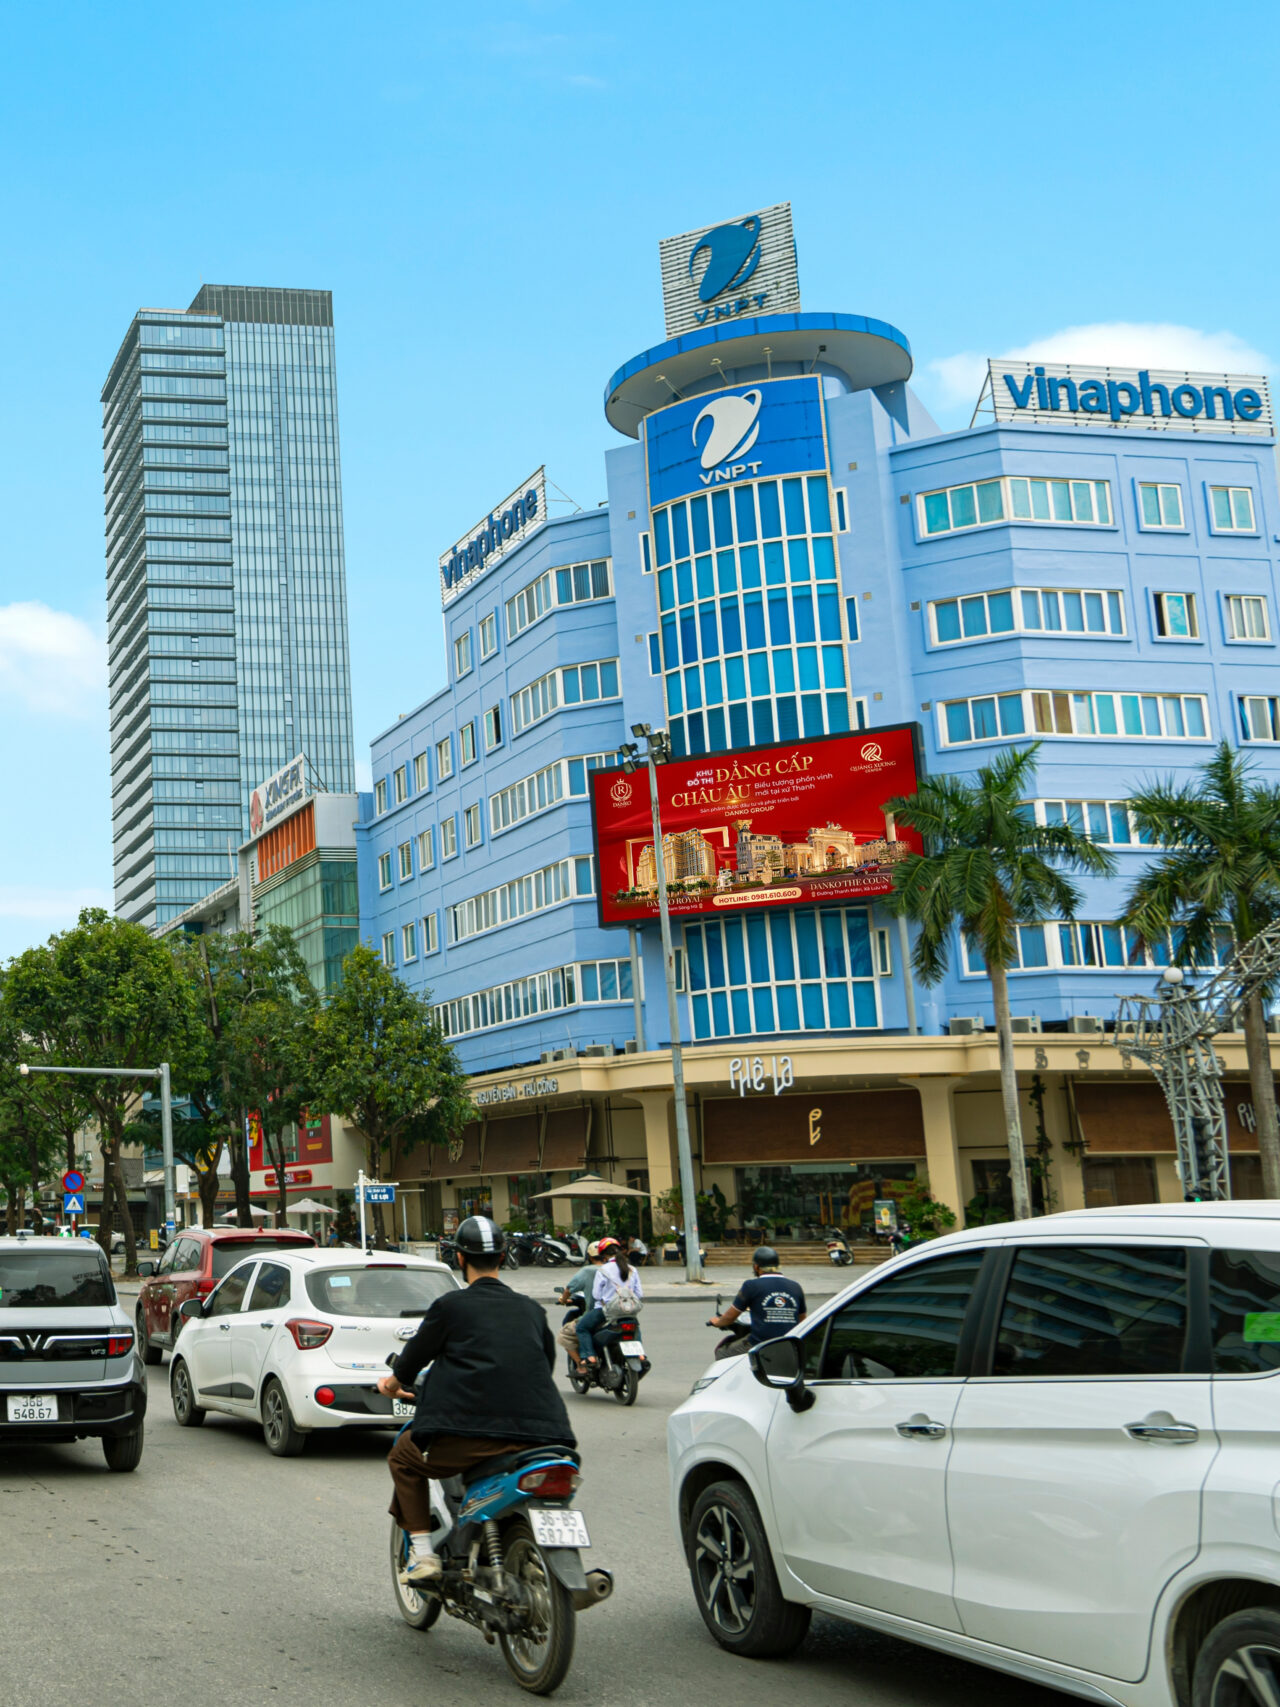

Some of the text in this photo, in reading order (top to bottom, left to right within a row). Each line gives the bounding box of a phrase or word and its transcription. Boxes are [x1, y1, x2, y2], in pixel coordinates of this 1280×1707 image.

[693, 293, 768, 324] VNPT
[1003, 366, 1264, 421] vinaphone
[698, 460, 763, 485] VNPT
[442, 489, 538, 589] vinaphone
[696, 769, 713, 778] KHU
[715, 751, 813, 783] ĐẲNG CẤP
[687, 777, 714, 787] ĐÔ THỊ
[816, 772, 833, 780] vinh
[792, 783, 815, 791] Thanh
[671, 783, 752, 808] CHÂU ÂU
[725, 805, 775, 817] DANKO GROUP
[810, 881, 841, 890] DANKO
[841, 879, 862, 887] THE
[718, 890, 797, 904] HOTLINE: 0981.610.600
[14, 1408, 52, 1419] 548.67
